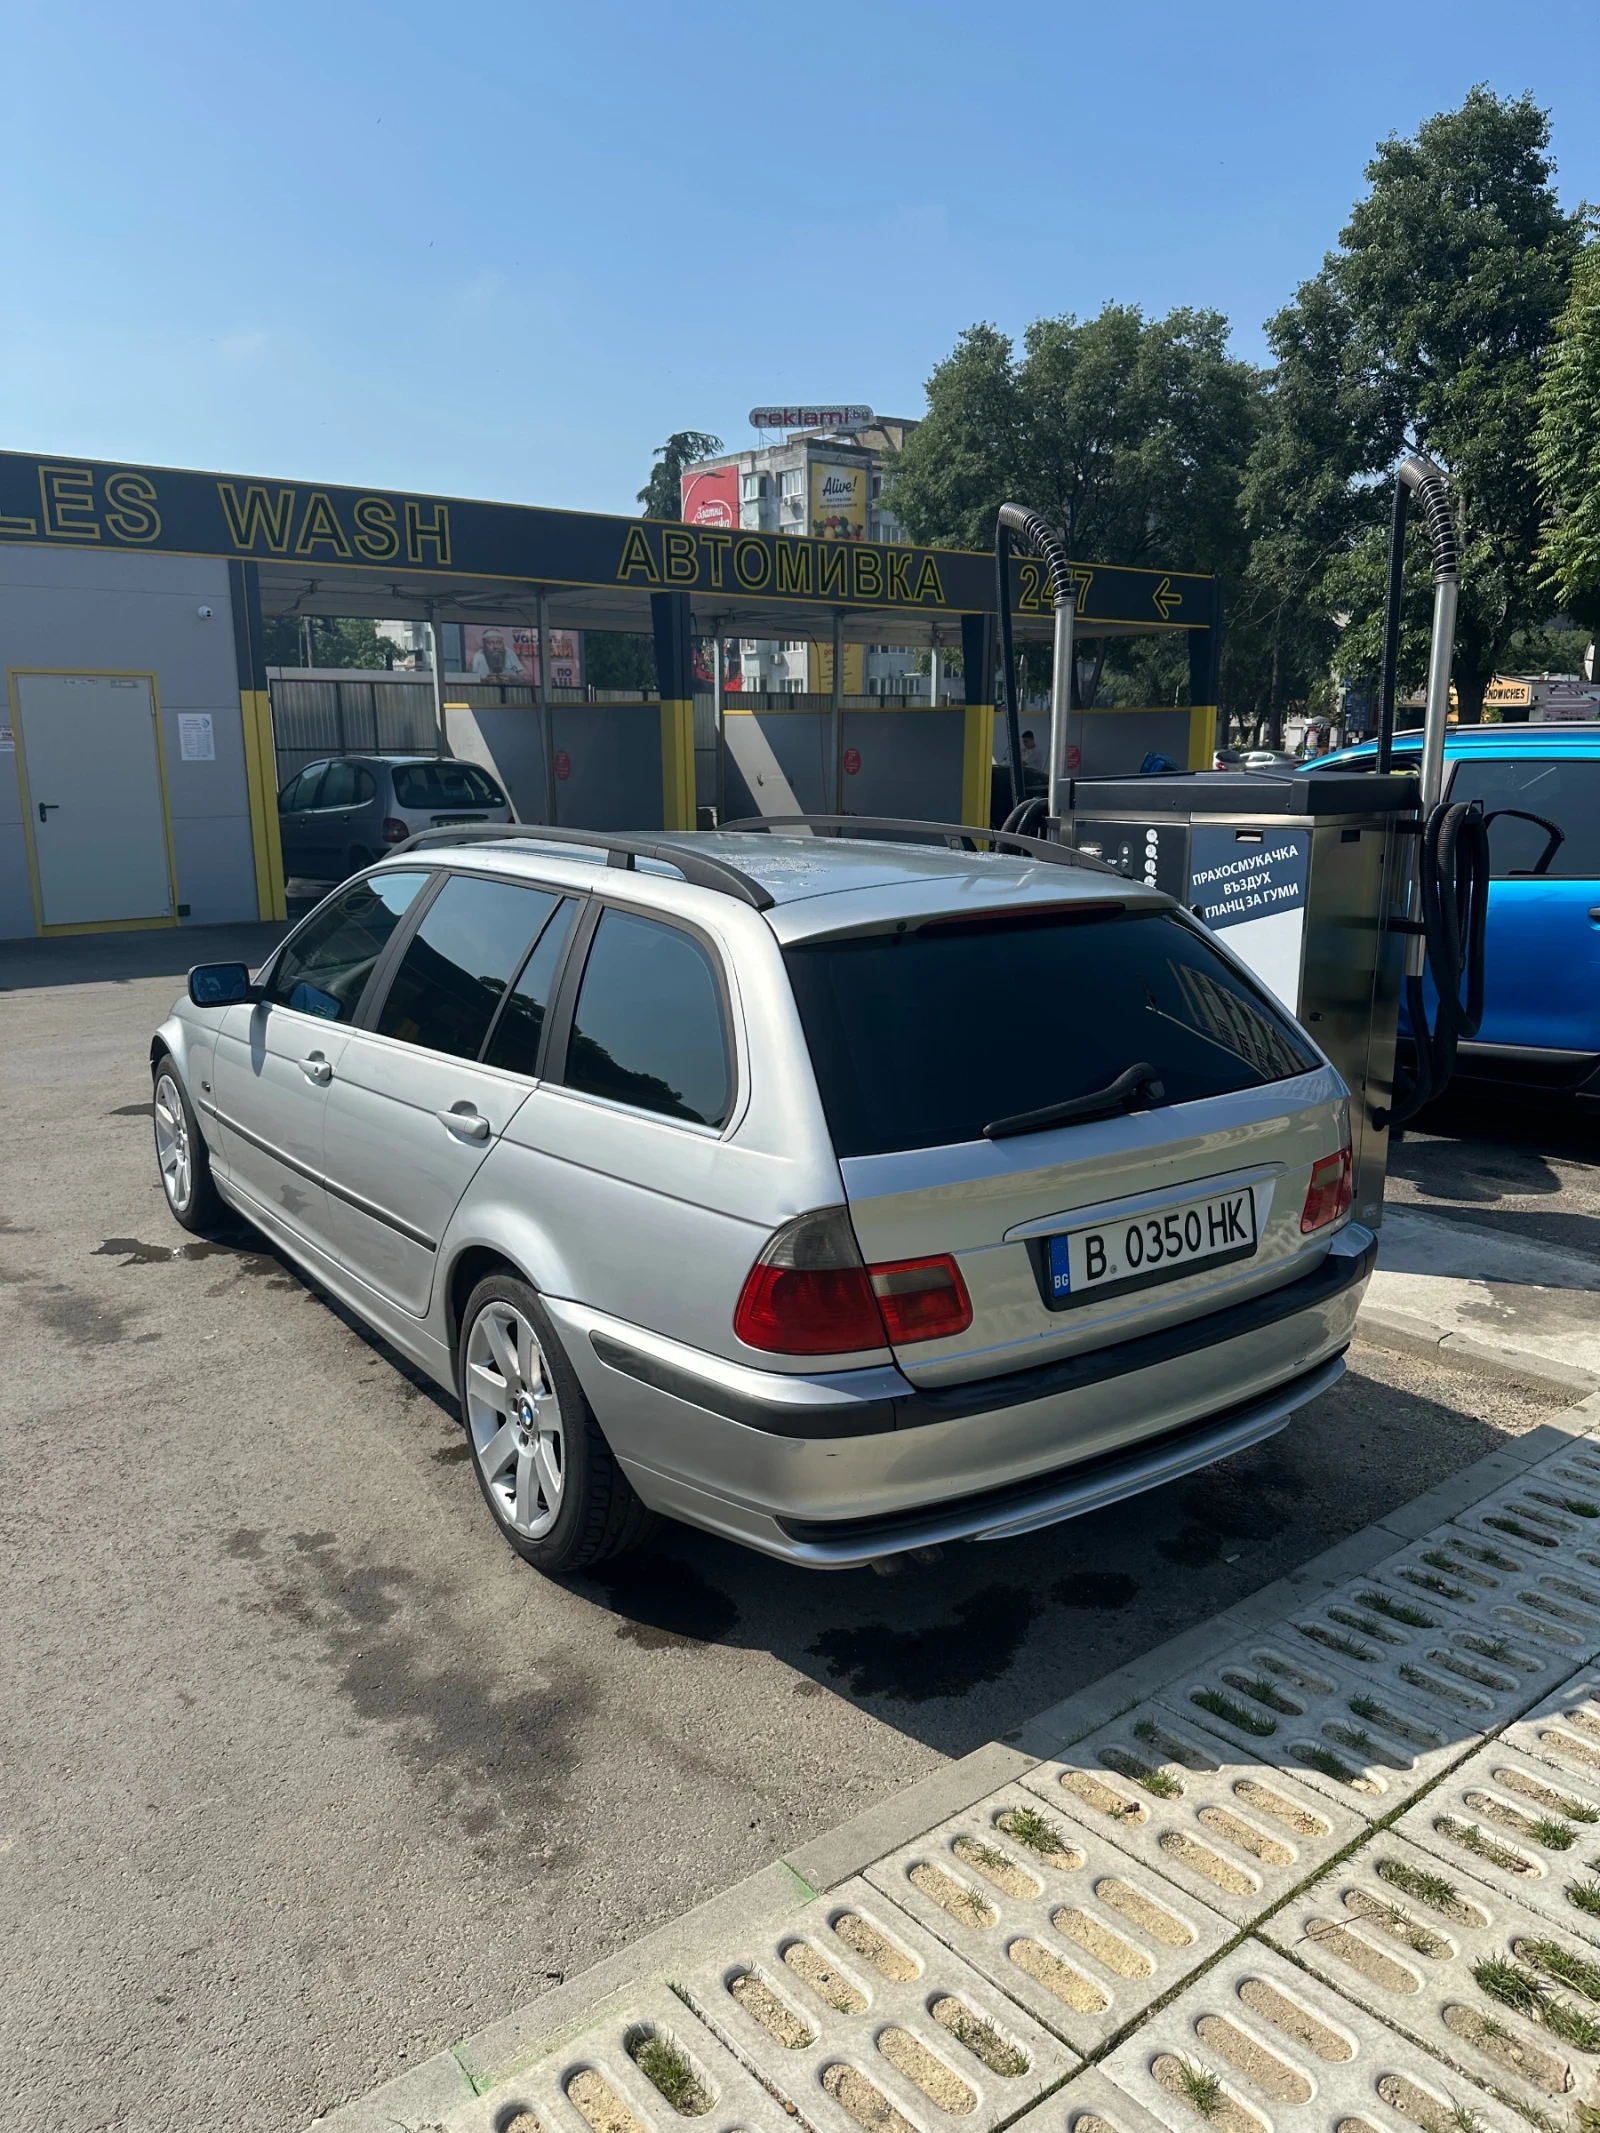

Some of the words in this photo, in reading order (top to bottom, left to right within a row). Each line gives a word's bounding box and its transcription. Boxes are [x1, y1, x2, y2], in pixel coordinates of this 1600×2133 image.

[822, 475, 858, 497] Alive!
[217, 482, 452, 565] WASH
[617, 526, 946, 604] АВТОМИВКА
[1019, 564, 1094, 613] 247
[1484, 688, 1526, 700] ANDWICHES
[1192, 844, 1299, 886] ПРАХОСМУКАЧКА
[1223, 871, 1272, 895] ВЪЗДУХ
[1204, 897, 1246, 919] ГЛАНЦ
[1245, 893, 1263, 908] ЗА
[1263, 882, 1300, 903] ГУМИ
[1085, 1234, 1108, 1281] B
[1125, 1210, 1202, 1269] 0350
[1207, 1197, 1248, 1248] HK
[1054, 1273, 1070, 1290] BG
